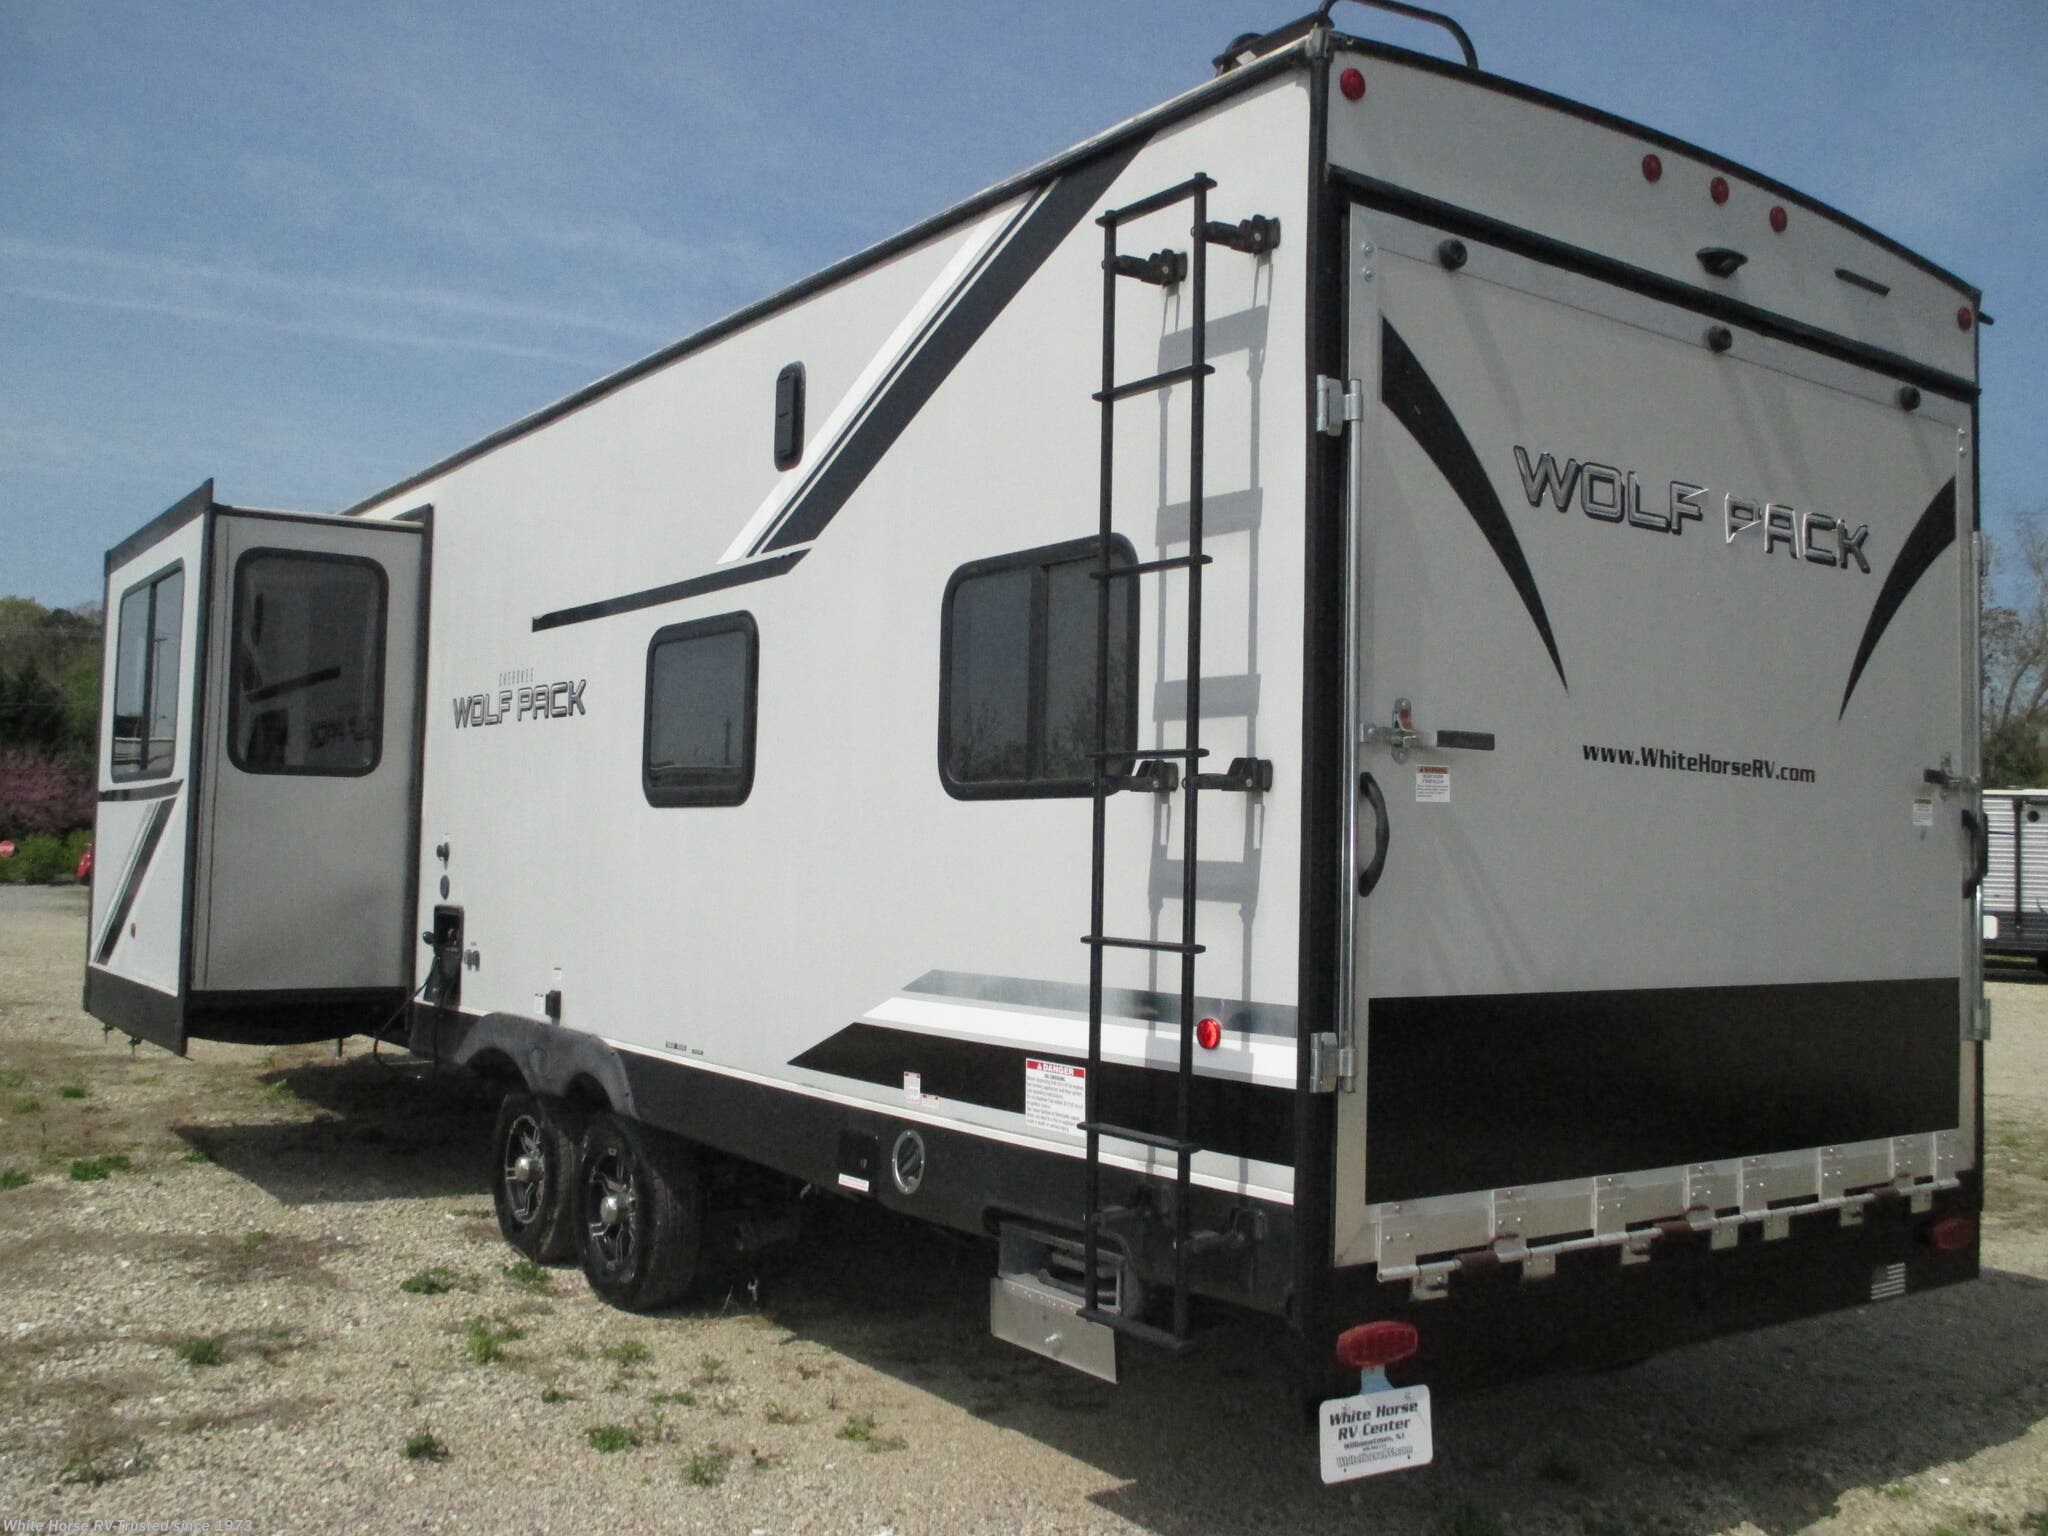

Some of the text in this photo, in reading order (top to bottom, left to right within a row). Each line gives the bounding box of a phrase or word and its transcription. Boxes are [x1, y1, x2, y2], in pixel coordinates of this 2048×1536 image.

[1513, 445, 1871, 574] WOLF PACK
[453, 679, 587, 729] WOLF PACK
[1582, 744, 1816, 784] www.WhiteHorseRV.com
[1329, 1402, 1418, 1427] White Horse
[1338, 1418, 1411, 1441] RV Center
